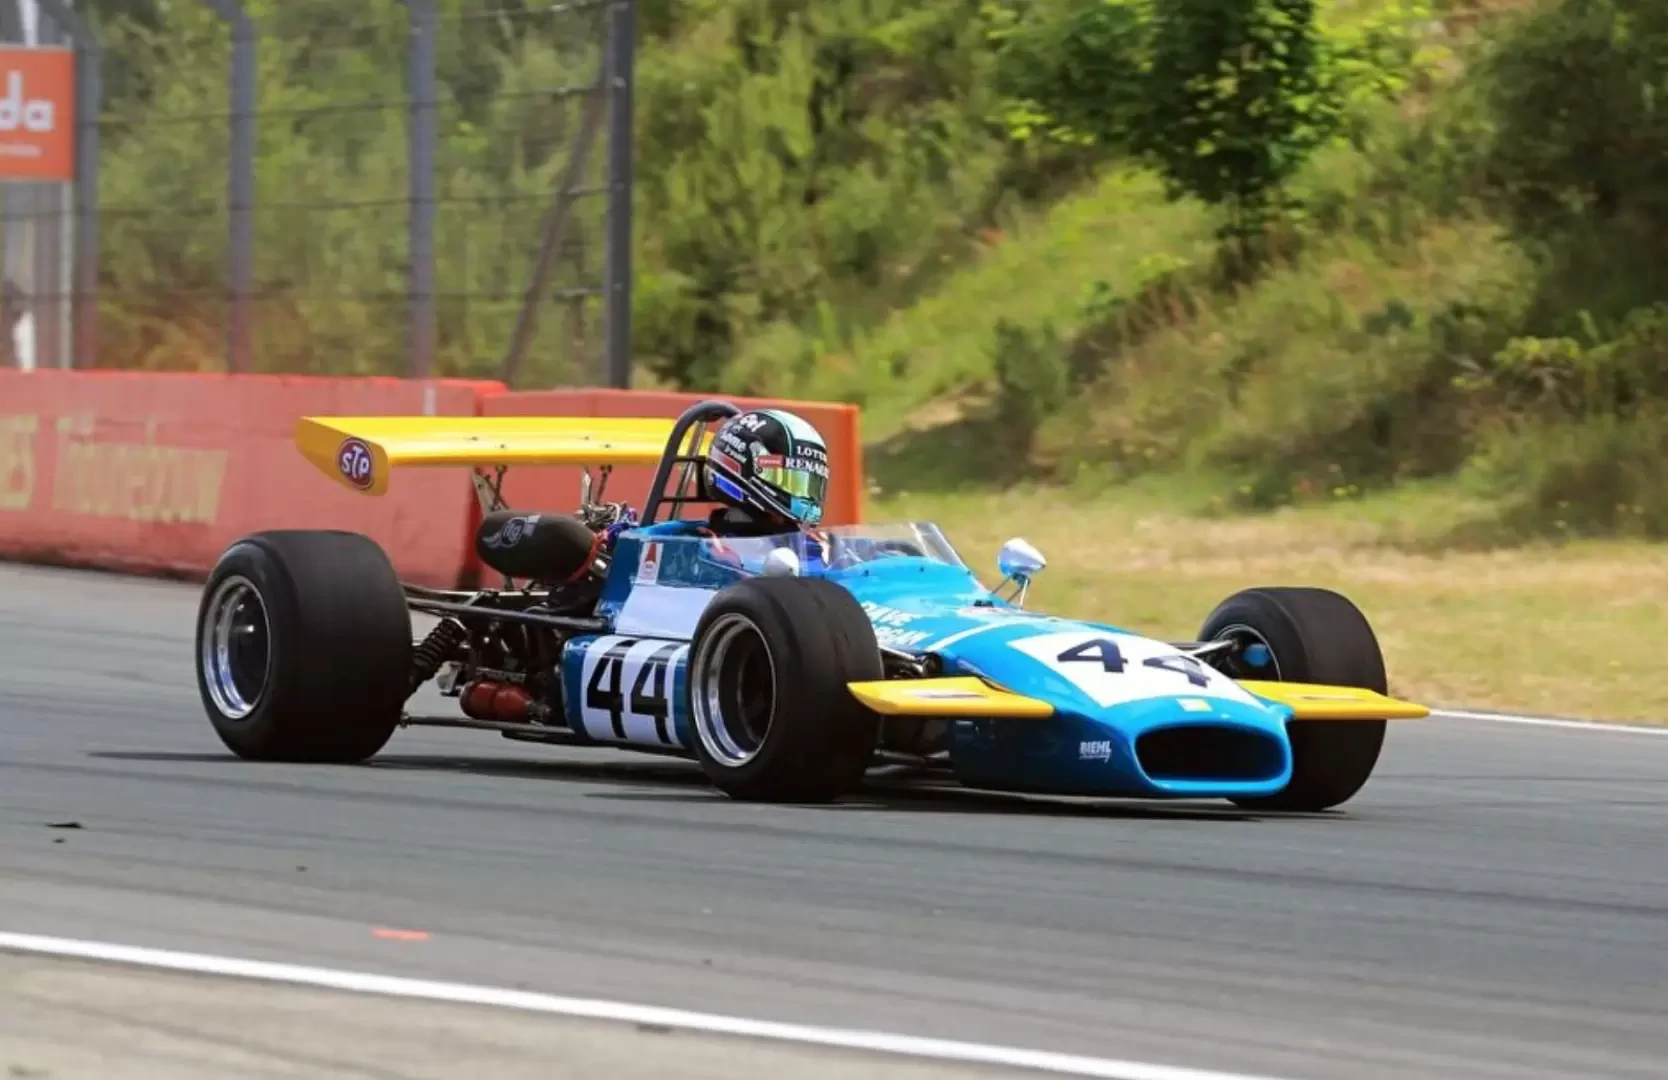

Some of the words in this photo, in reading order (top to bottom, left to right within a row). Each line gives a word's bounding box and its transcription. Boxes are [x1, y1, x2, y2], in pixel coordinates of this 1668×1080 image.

[341, 446, 370, 479] STP
[1057, 638, 1212, 688] 44
[587, 639, 672, 745] 44
